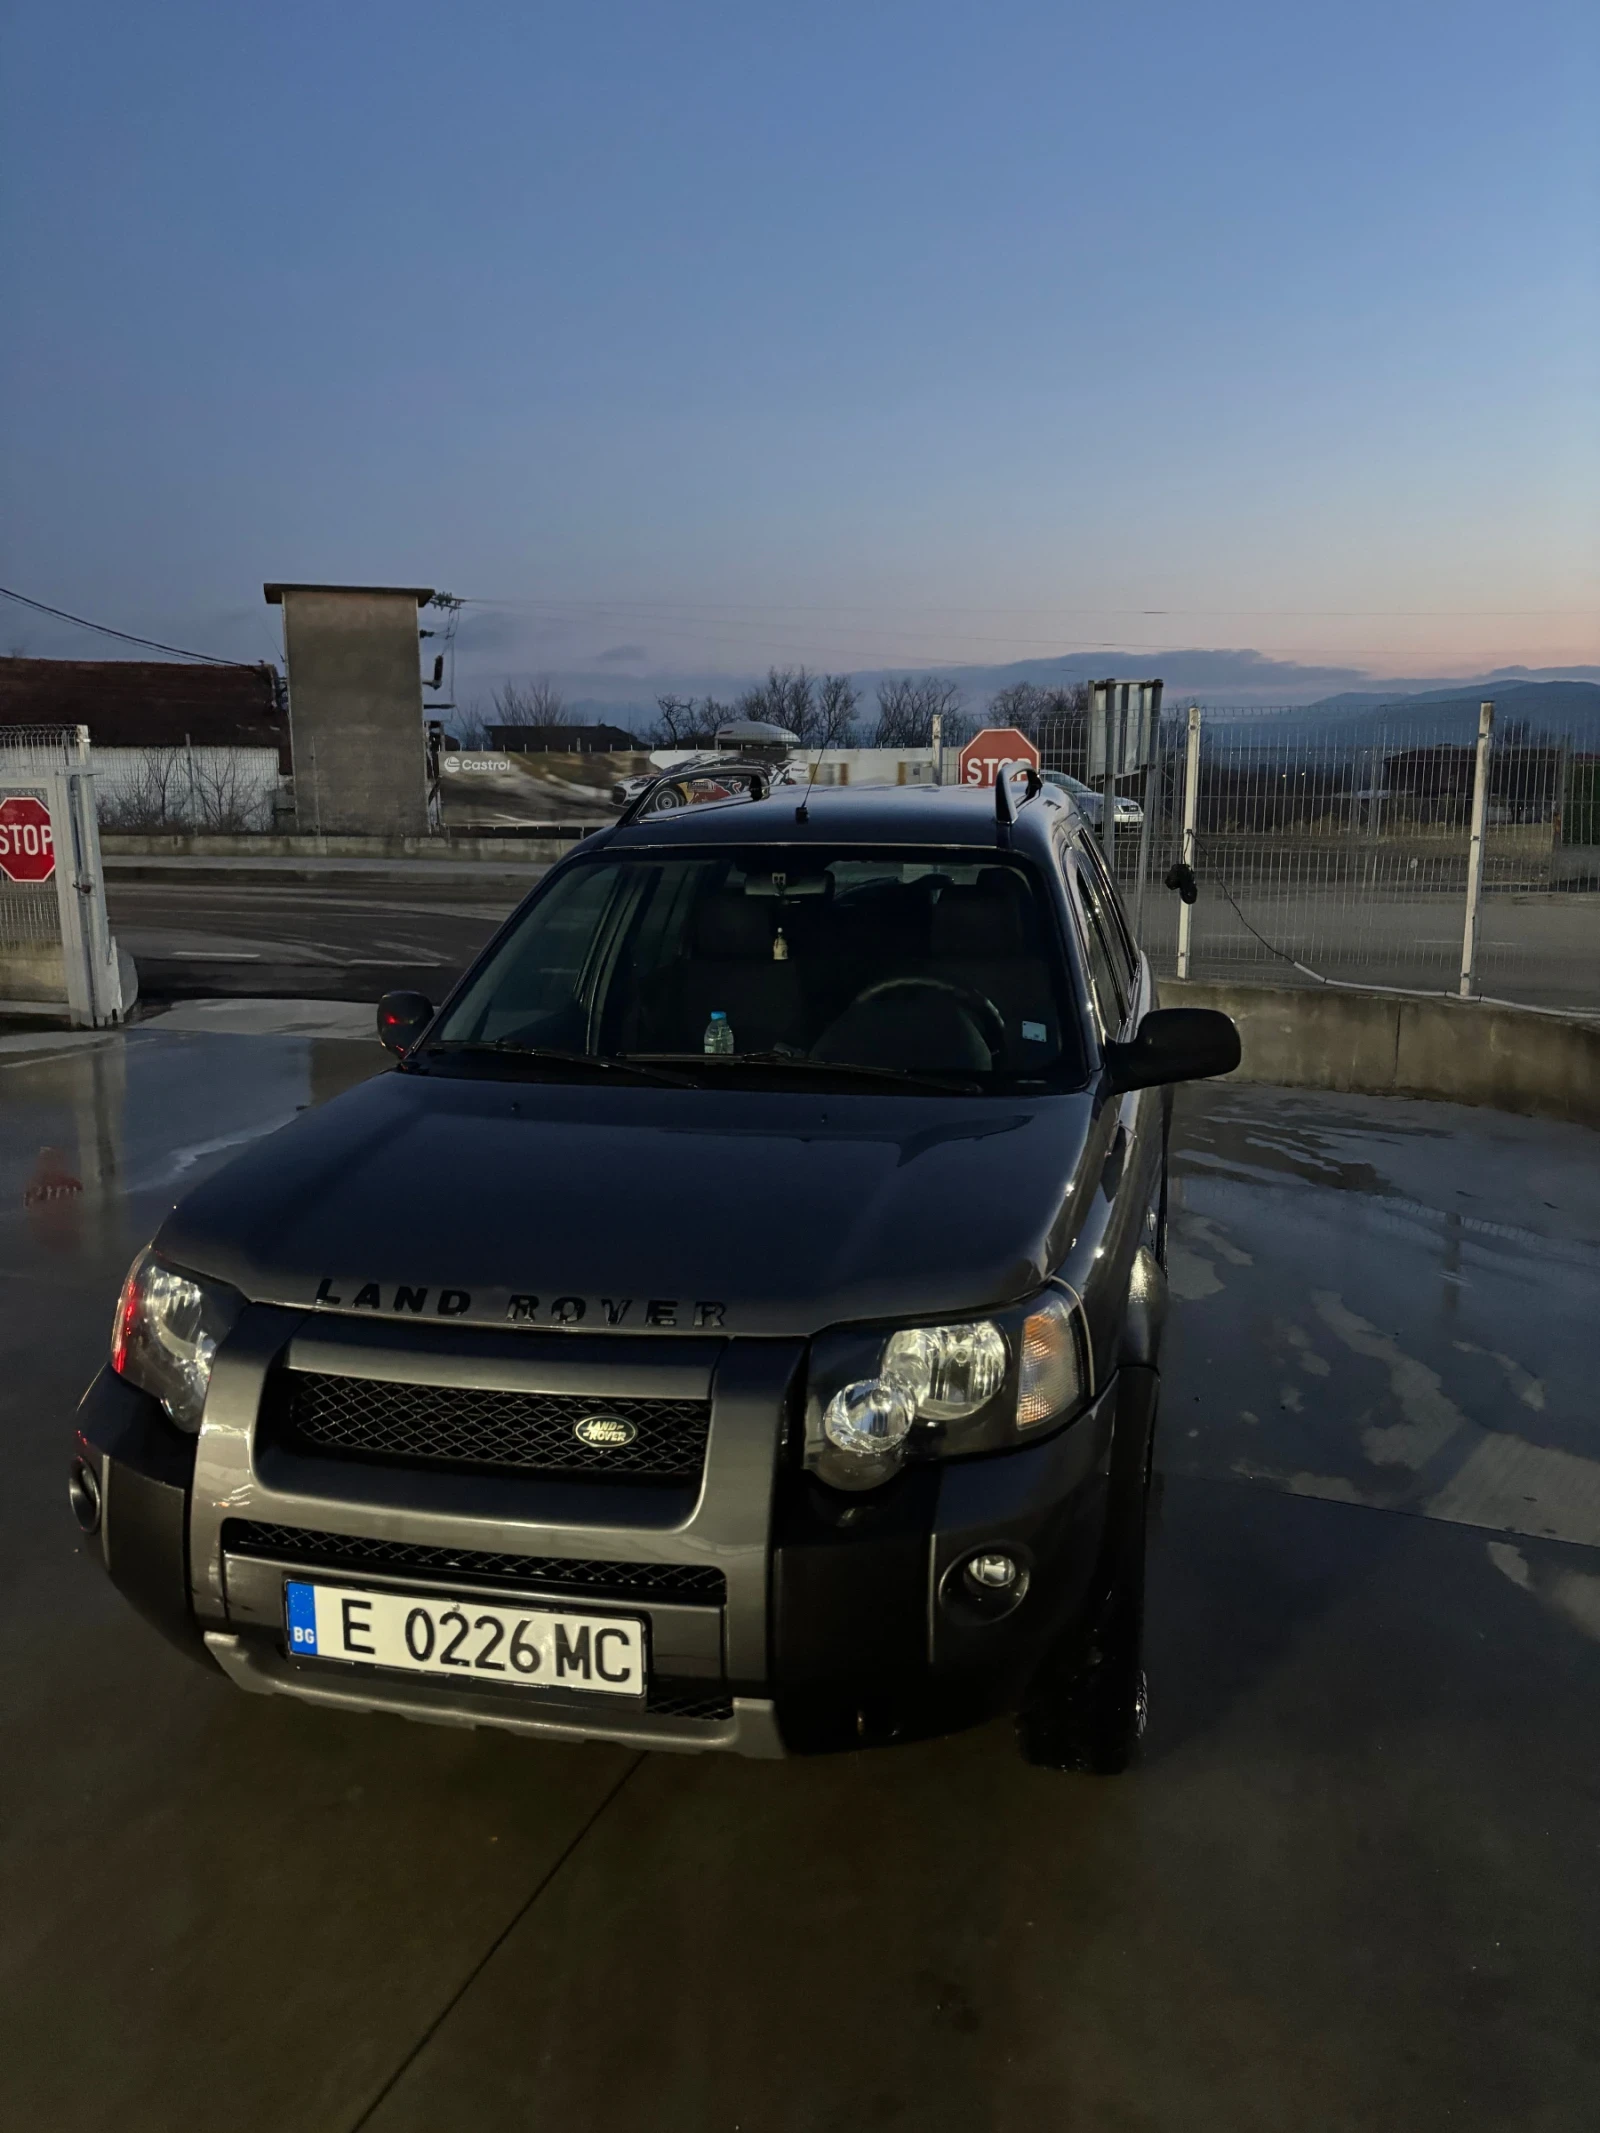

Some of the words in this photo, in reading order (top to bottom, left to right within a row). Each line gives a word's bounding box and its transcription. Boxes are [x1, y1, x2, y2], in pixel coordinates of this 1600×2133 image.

[462, 760, 511, 771] Castrol
[0, 824, 52, 856] STOP
[315, 1278, 472, 1317] LAND
[506, 1293, 728, 1328] ROVER
[293, 1626, 315, 1645] BG
[341, 1598, 375, 1655] E
[405, 1607, 541, 1674] 0226
[554, 1622, 631, 1683] MC
